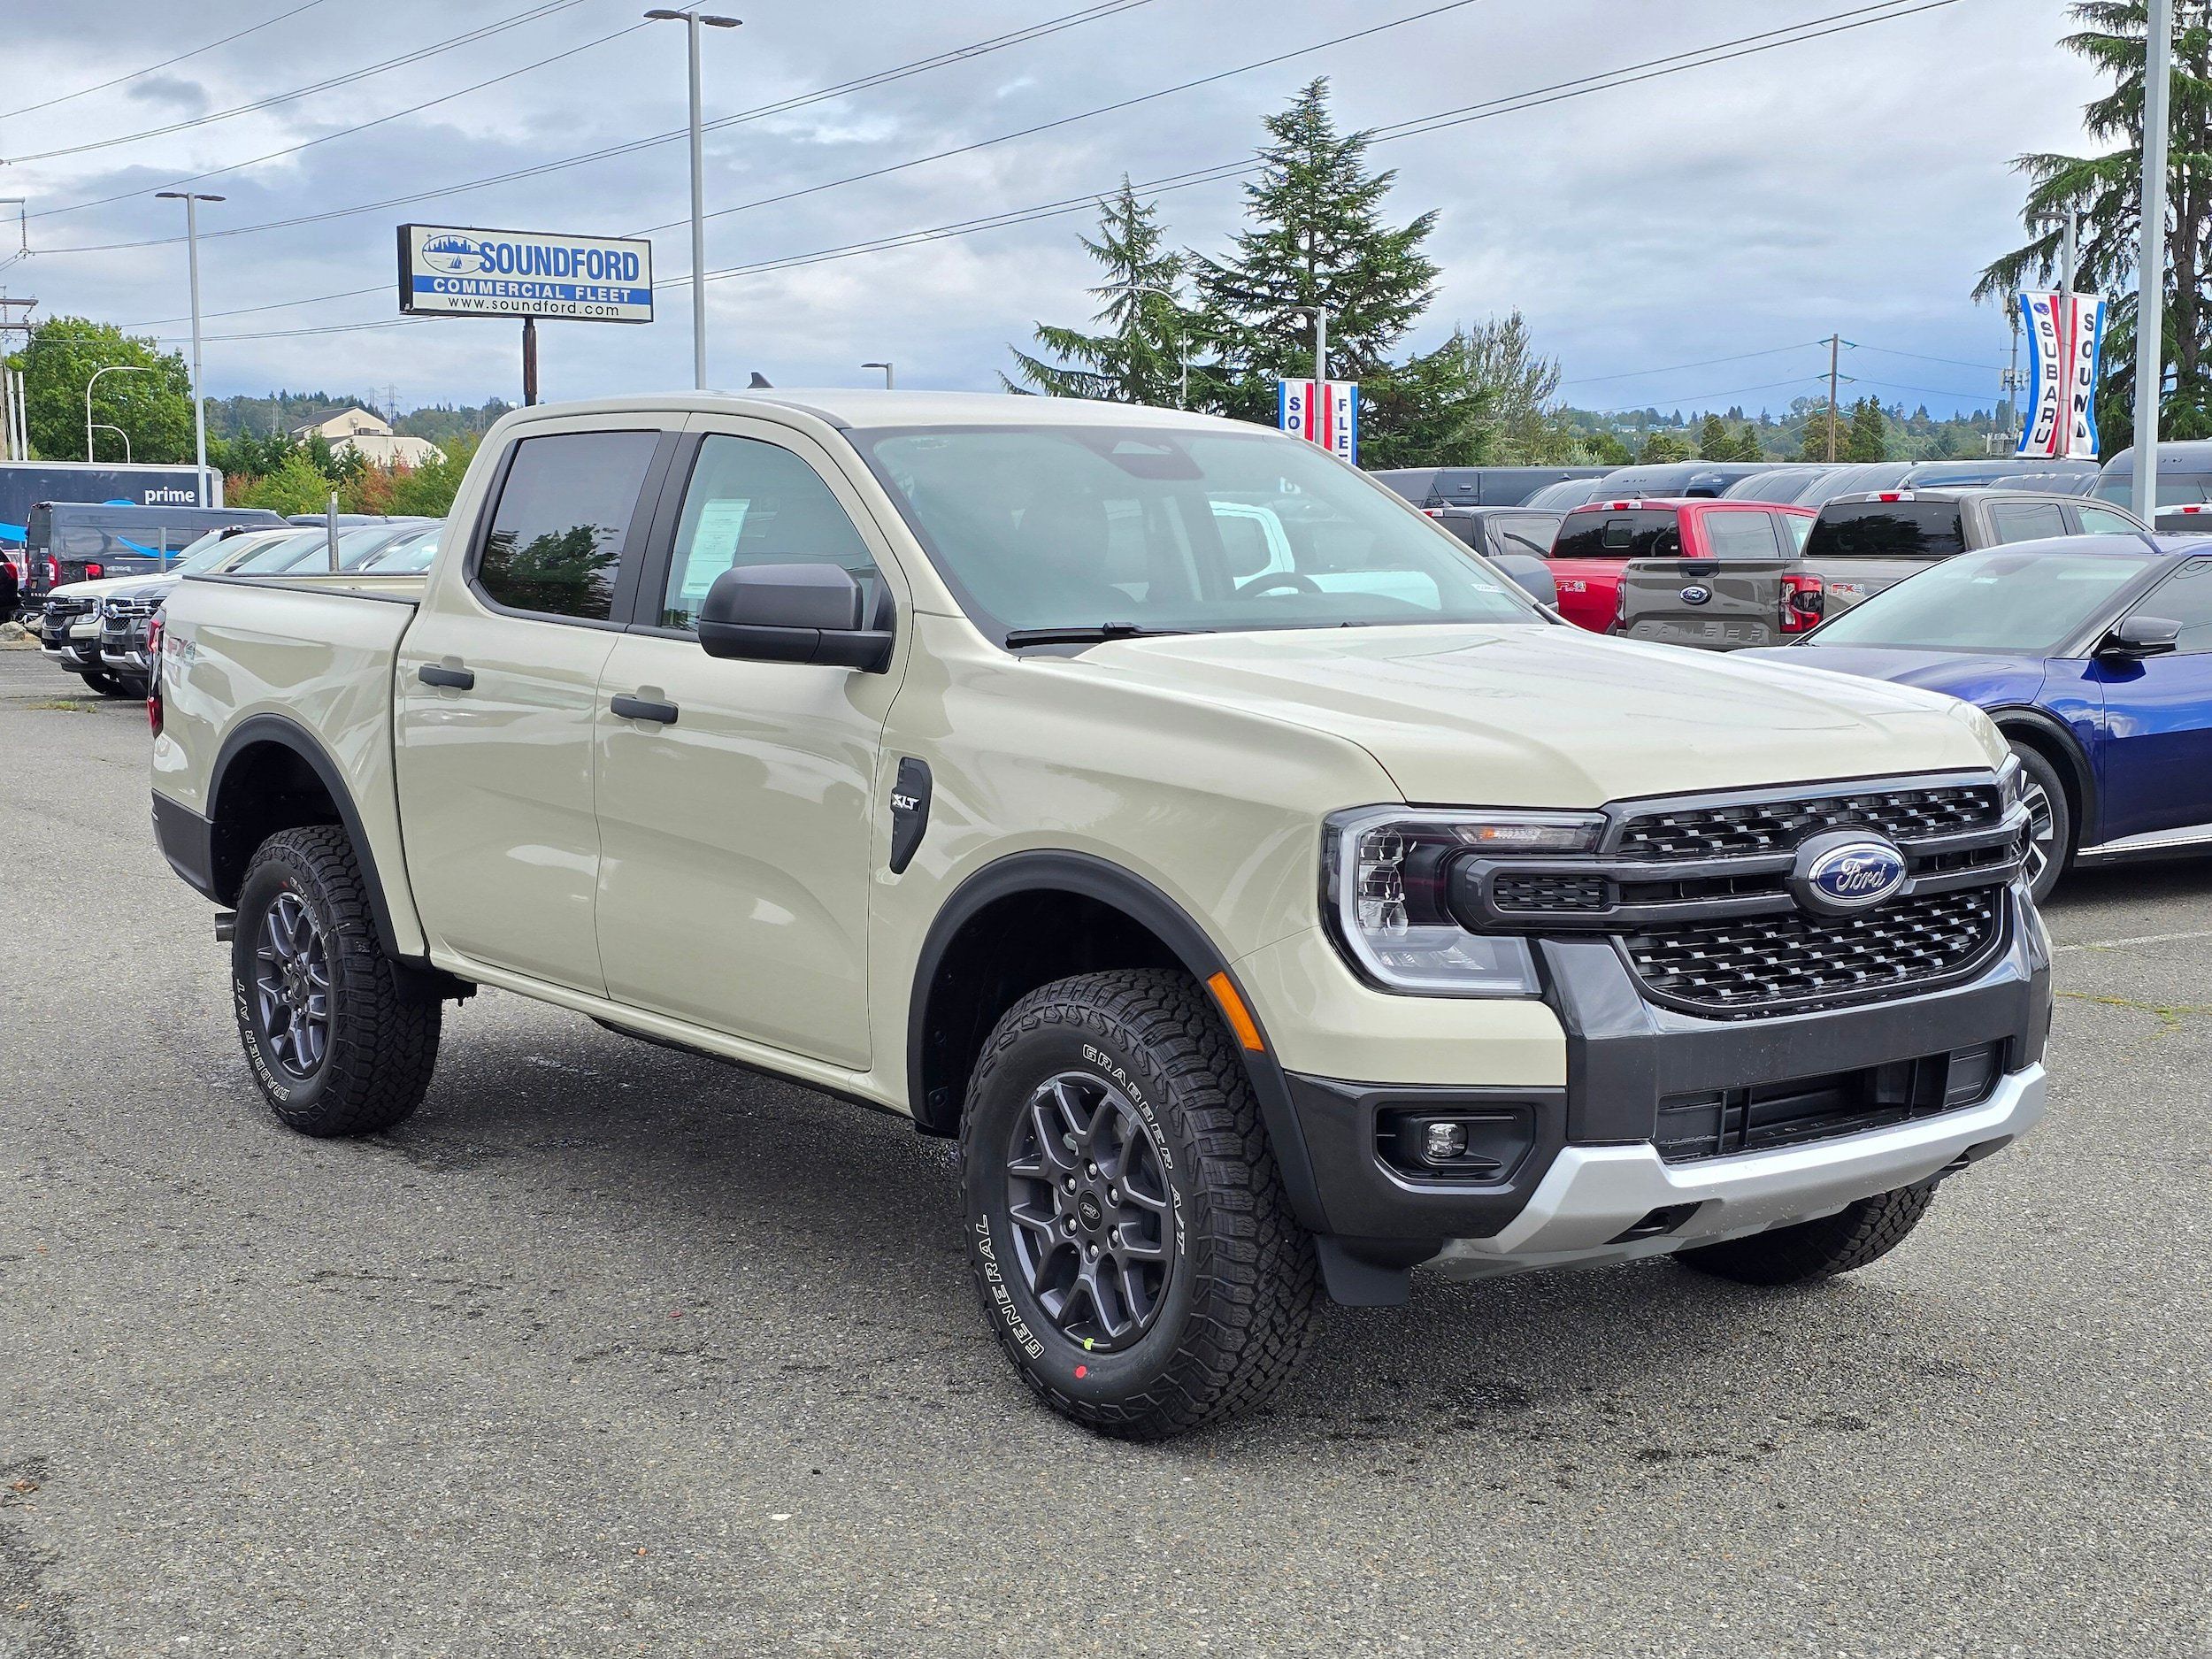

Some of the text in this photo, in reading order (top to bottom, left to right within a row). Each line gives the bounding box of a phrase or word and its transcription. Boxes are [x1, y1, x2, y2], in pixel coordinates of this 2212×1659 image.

[479, 242, 640, 282] SOUNDFORD
[433, 278, 631, 303] COMMERCIAL FLEET
[448, 296, 619, 316] www.soundford.com
[2035, 320, 2058, 444] SUBARU
[2073, 313, 2094, 439] SOUND
[144, 486, 196, 505] prime
[1831, 583, 1865, 595] FX4
[1637, 625, 1764, 643] RANGER
[167, 636, 196, 661] FX4
[892, 793, 920, 810] XLT
[1836, 857, 1886, 892] Ford
[1082, 1043, 1187, 1256] GRABBER A/T
[975, 1213, 1045, 1360] GENERAL
